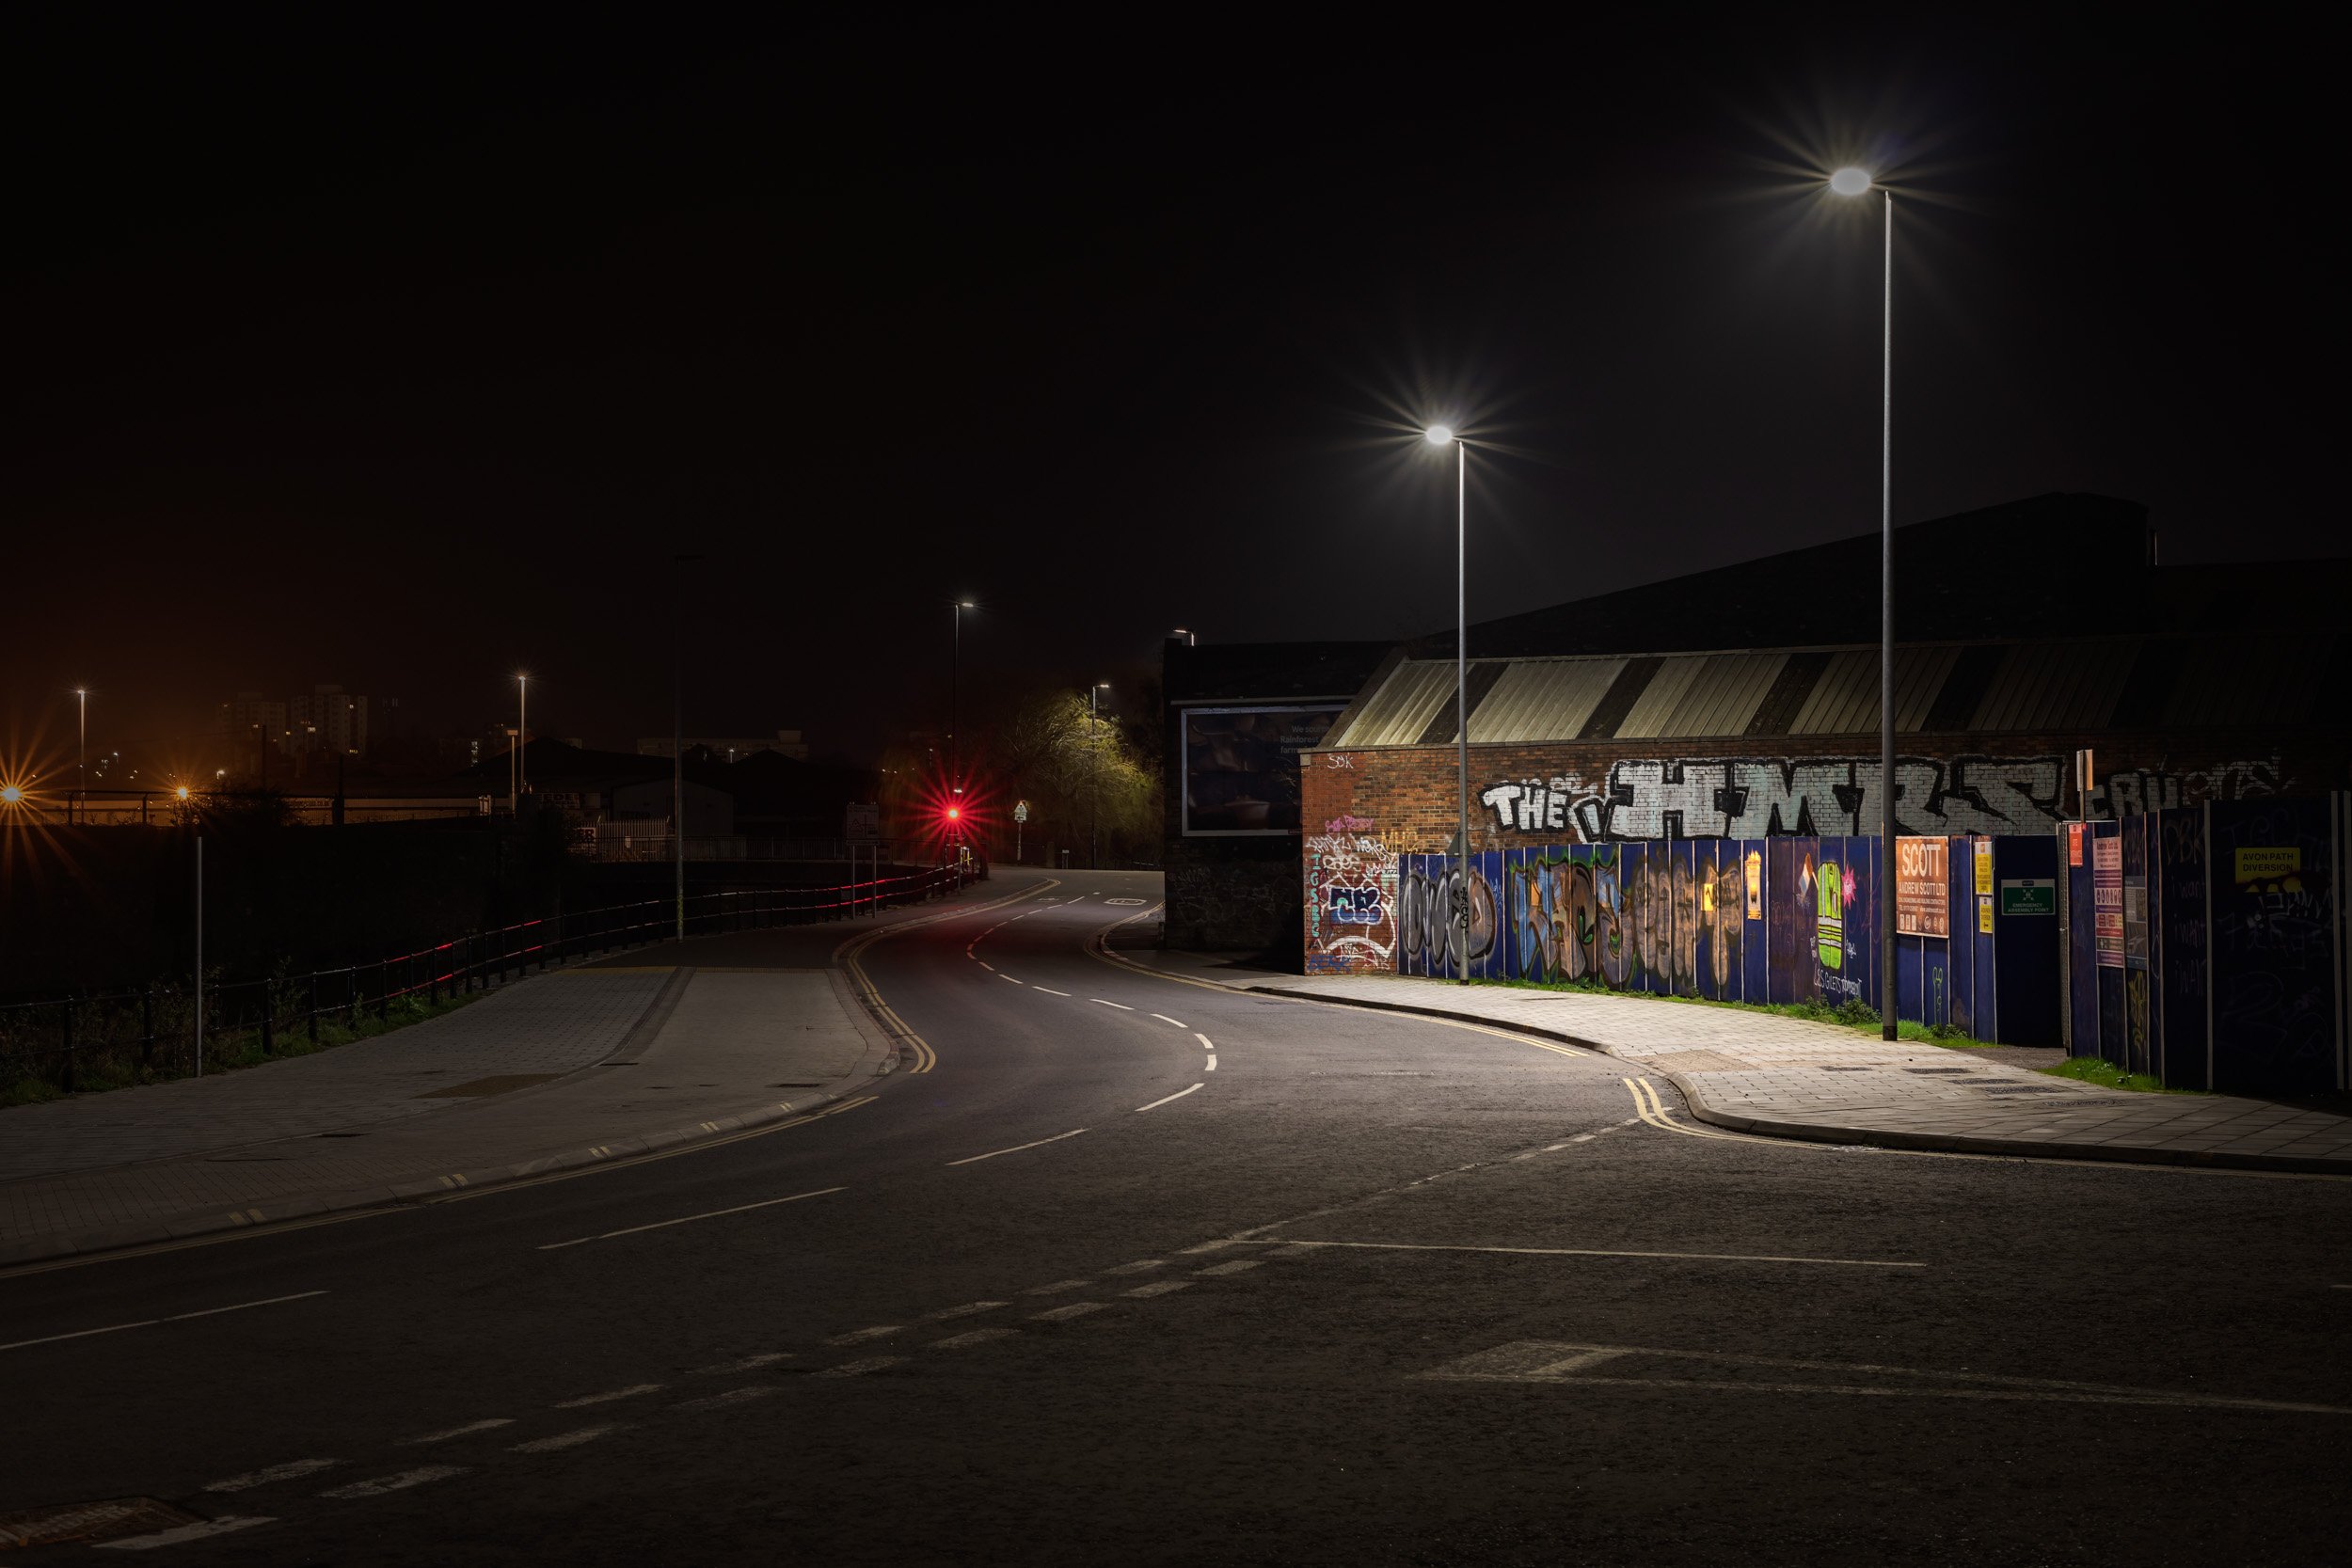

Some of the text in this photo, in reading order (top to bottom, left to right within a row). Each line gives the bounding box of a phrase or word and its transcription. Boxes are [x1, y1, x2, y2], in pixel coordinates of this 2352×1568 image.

[1291, 723, 1305, 734] We
[1279, 735, 1320, 745] Rainforest
[1478, 782, 1569, 833] THE
[1902, 843, 1941, 877] SCOTT
[2243, 852, 2294, 861] AVON PATH
[2243, 863, 2293, 872] DIVERSION
[1899, 881, 1946, 896] ANDREW SCOTT LTD
